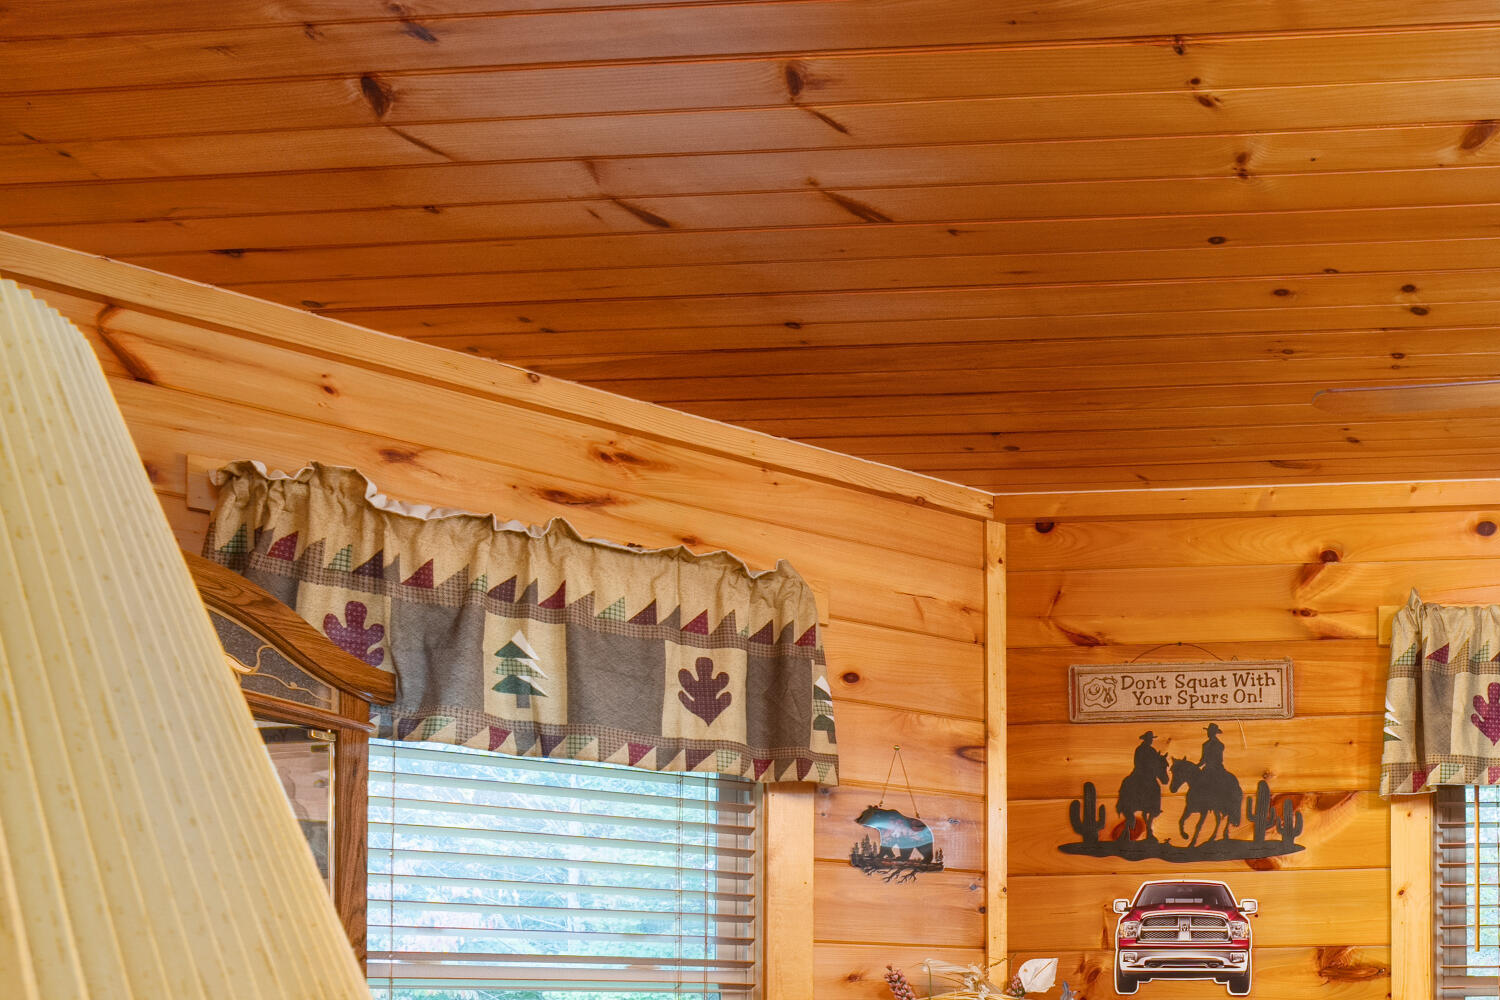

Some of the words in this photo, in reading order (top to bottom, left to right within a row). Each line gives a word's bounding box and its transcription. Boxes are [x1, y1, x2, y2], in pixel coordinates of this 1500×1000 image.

[1120, 675, 1166, 690] Don't
[1175, 674, 1227, 693] Squat
[1232, 671, 1276, 688] With
[1132, 690, 1172, 706] Your
[1177, 689, 1229, 708] Spurs
[1233, 687, 1263, 704] On!
